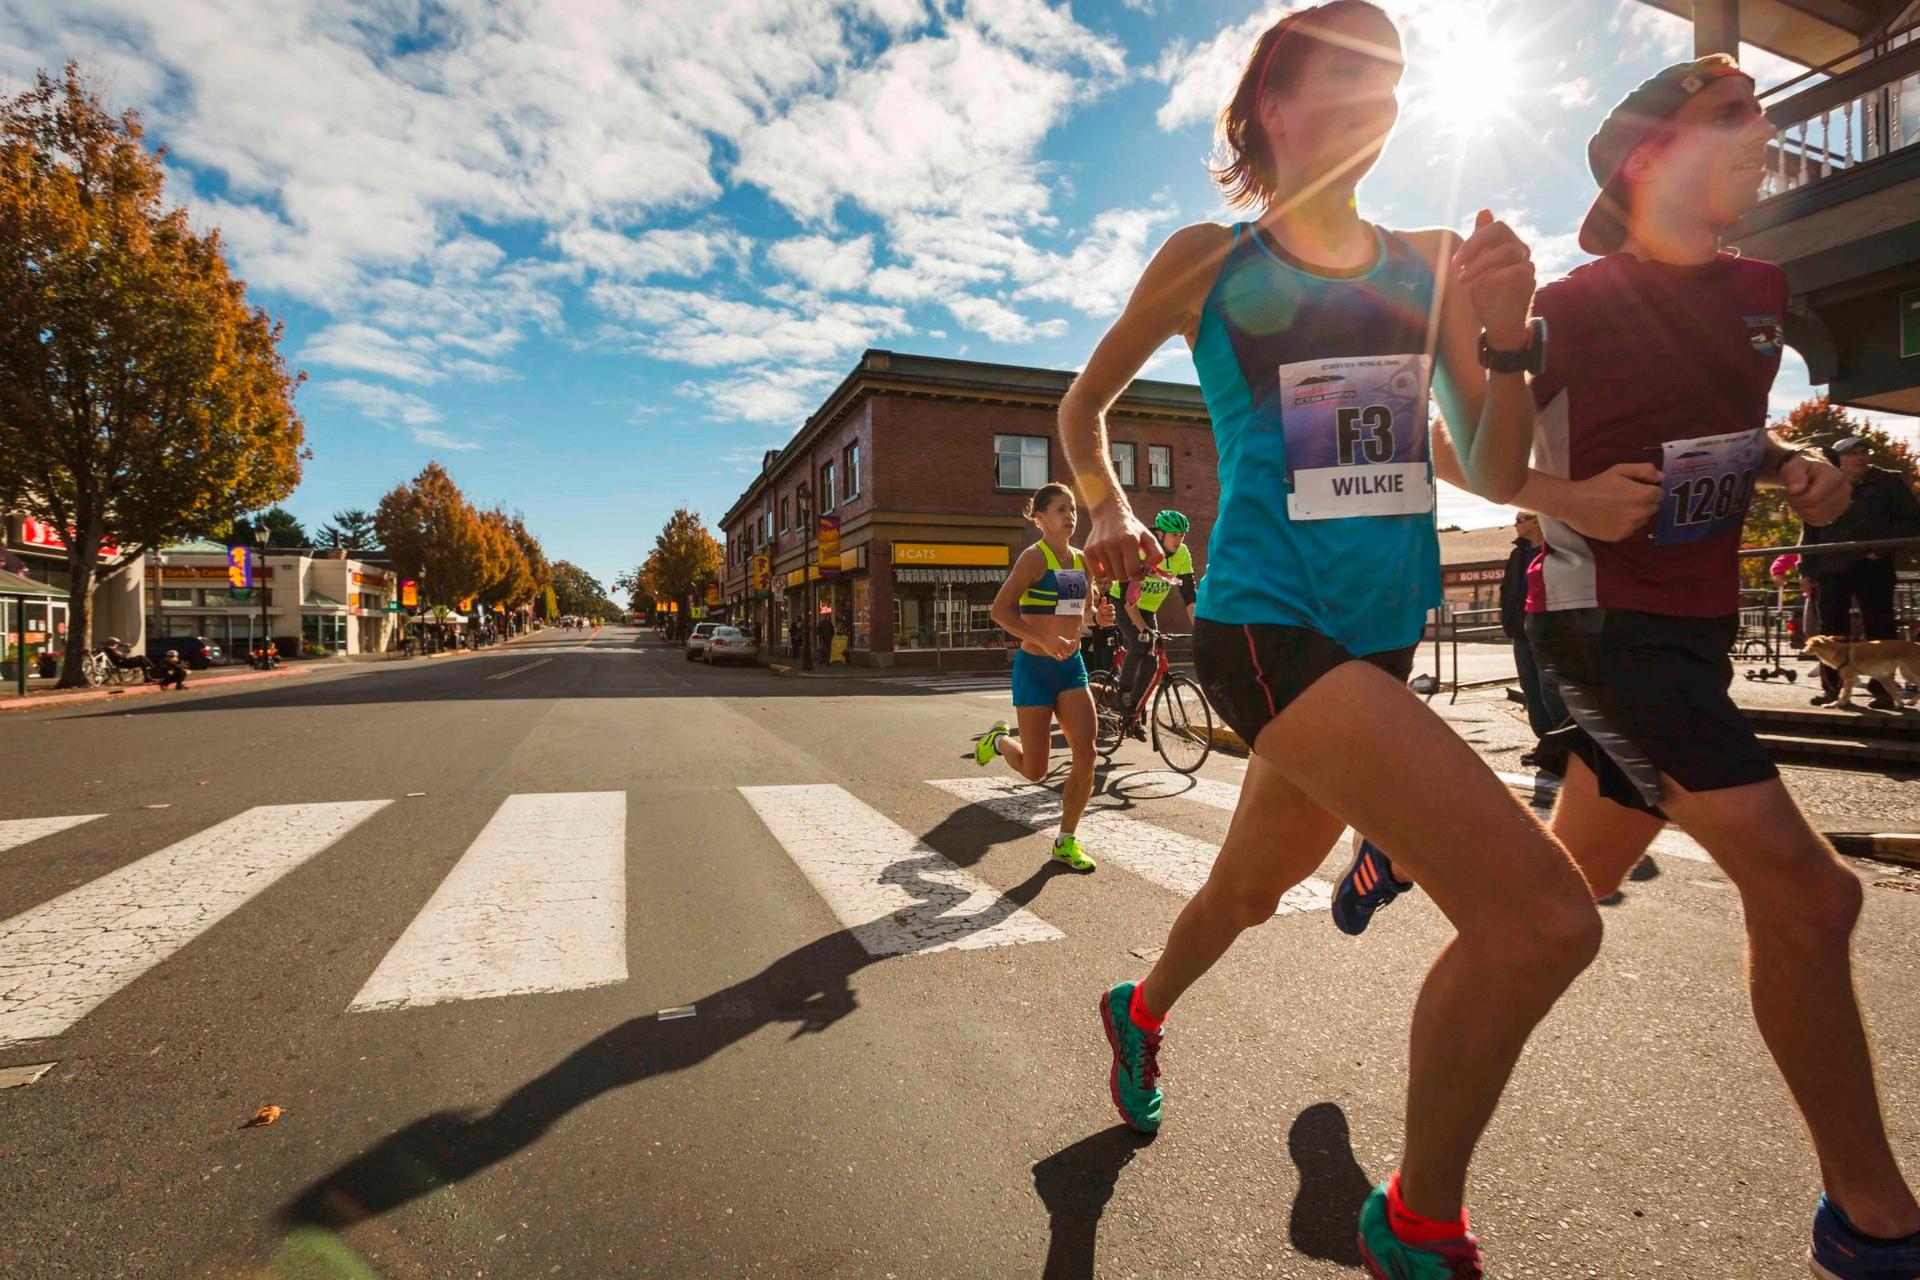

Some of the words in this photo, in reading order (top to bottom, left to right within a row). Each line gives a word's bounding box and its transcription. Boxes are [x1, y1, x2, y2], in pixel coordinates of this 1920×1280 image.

[1337, 405, 1395, 465] F3
[1332, 474, 1404, 497] WILKIE
[899, 549, 936, 559] 4CATS
[1460, 571, 1480, 581] BON
